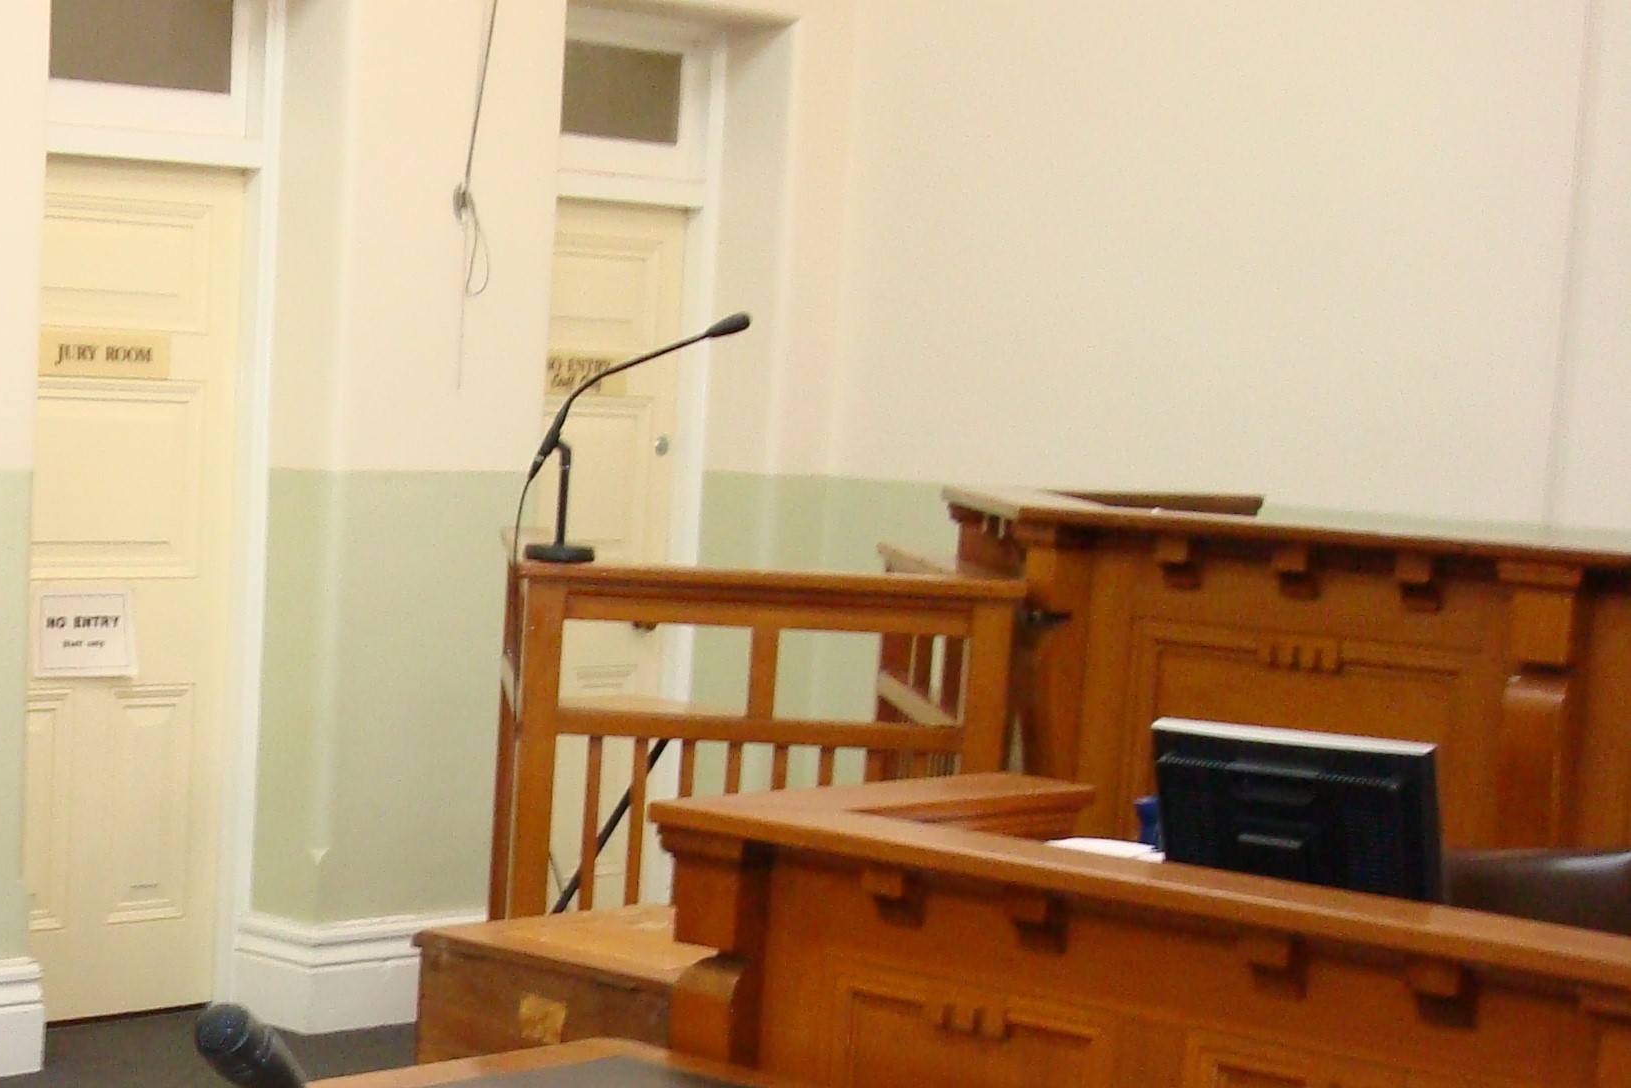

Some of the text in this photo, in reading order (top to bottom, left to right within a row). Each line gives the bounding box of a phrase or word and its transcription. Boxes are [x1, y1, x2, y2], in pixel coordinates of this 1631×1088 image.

[54, 343, 152, 366] JURY ROOM
[567, 357, 612, 373] ENTRY
[46, 615, 120, 629] NO ENTRY
